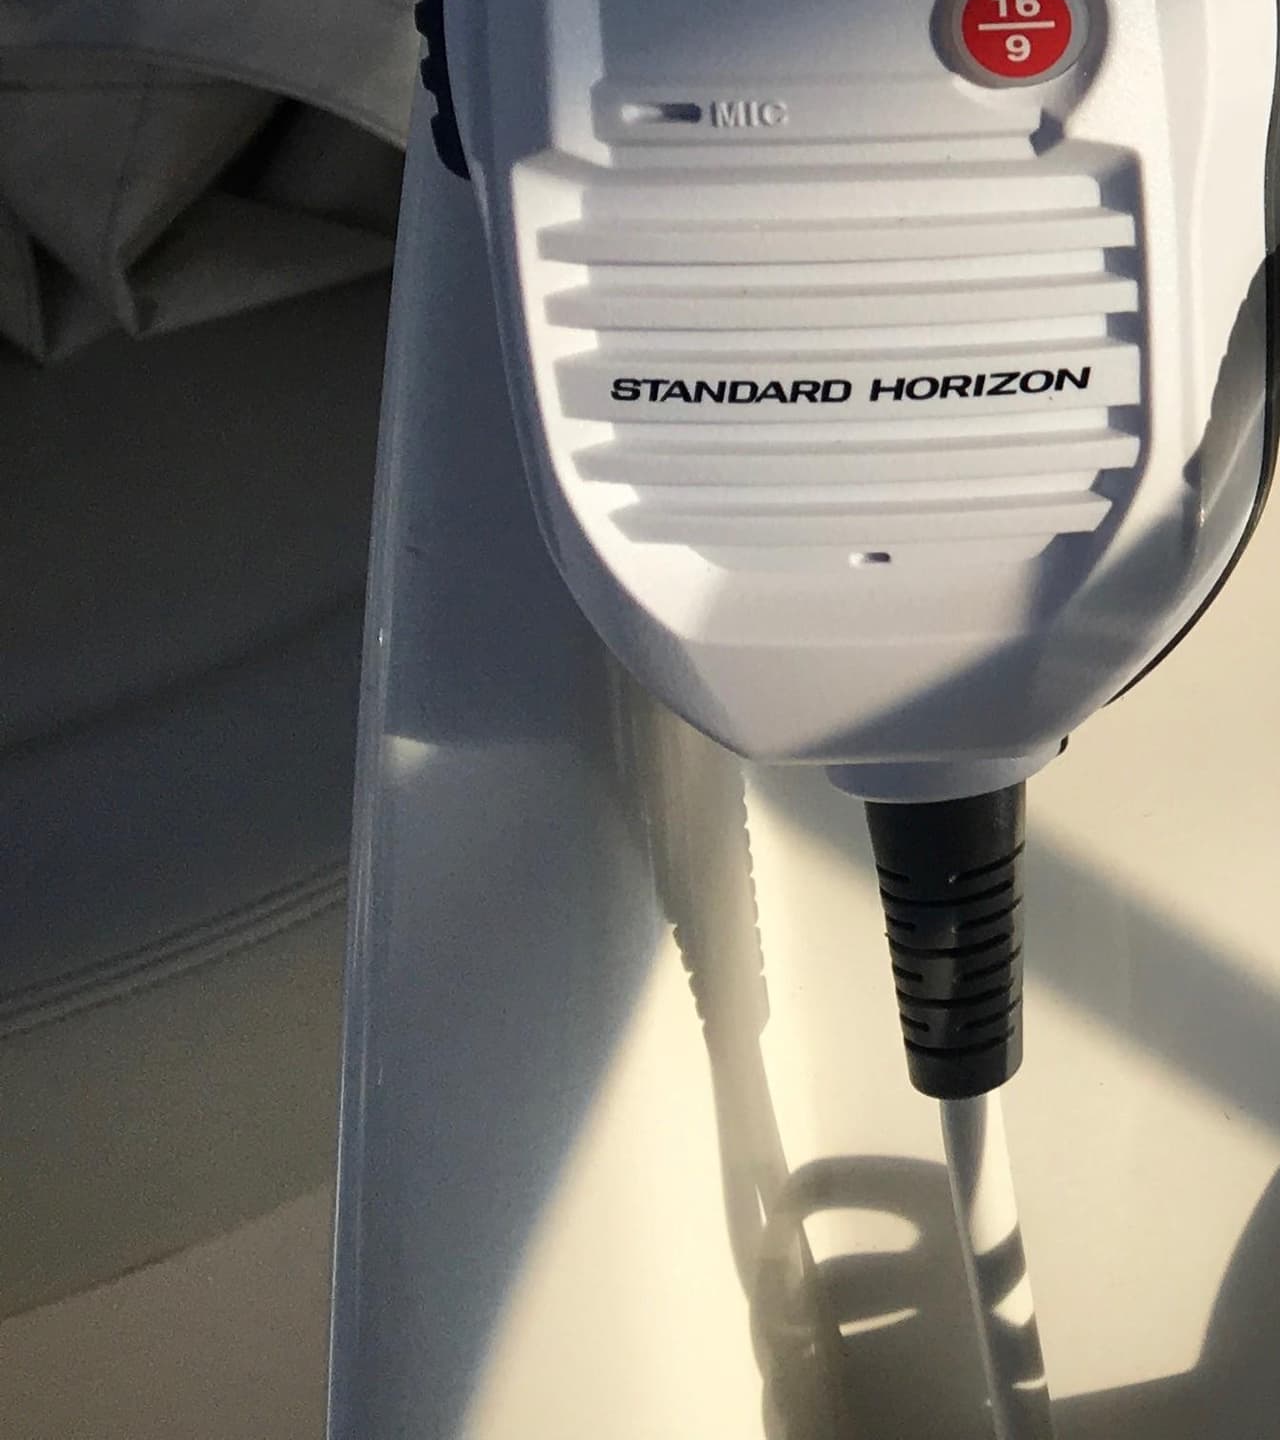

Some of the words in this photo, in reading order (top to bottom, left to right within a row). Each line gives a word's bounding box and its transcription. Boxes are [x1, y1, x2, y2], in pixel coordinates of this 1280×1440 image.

[1005, 34, 1032, 62] 9
[710, 99, 789, 129] MIC
[610, 378, 852, 404] STANDARD
[869, 366, 1092, 402] HORIZON
